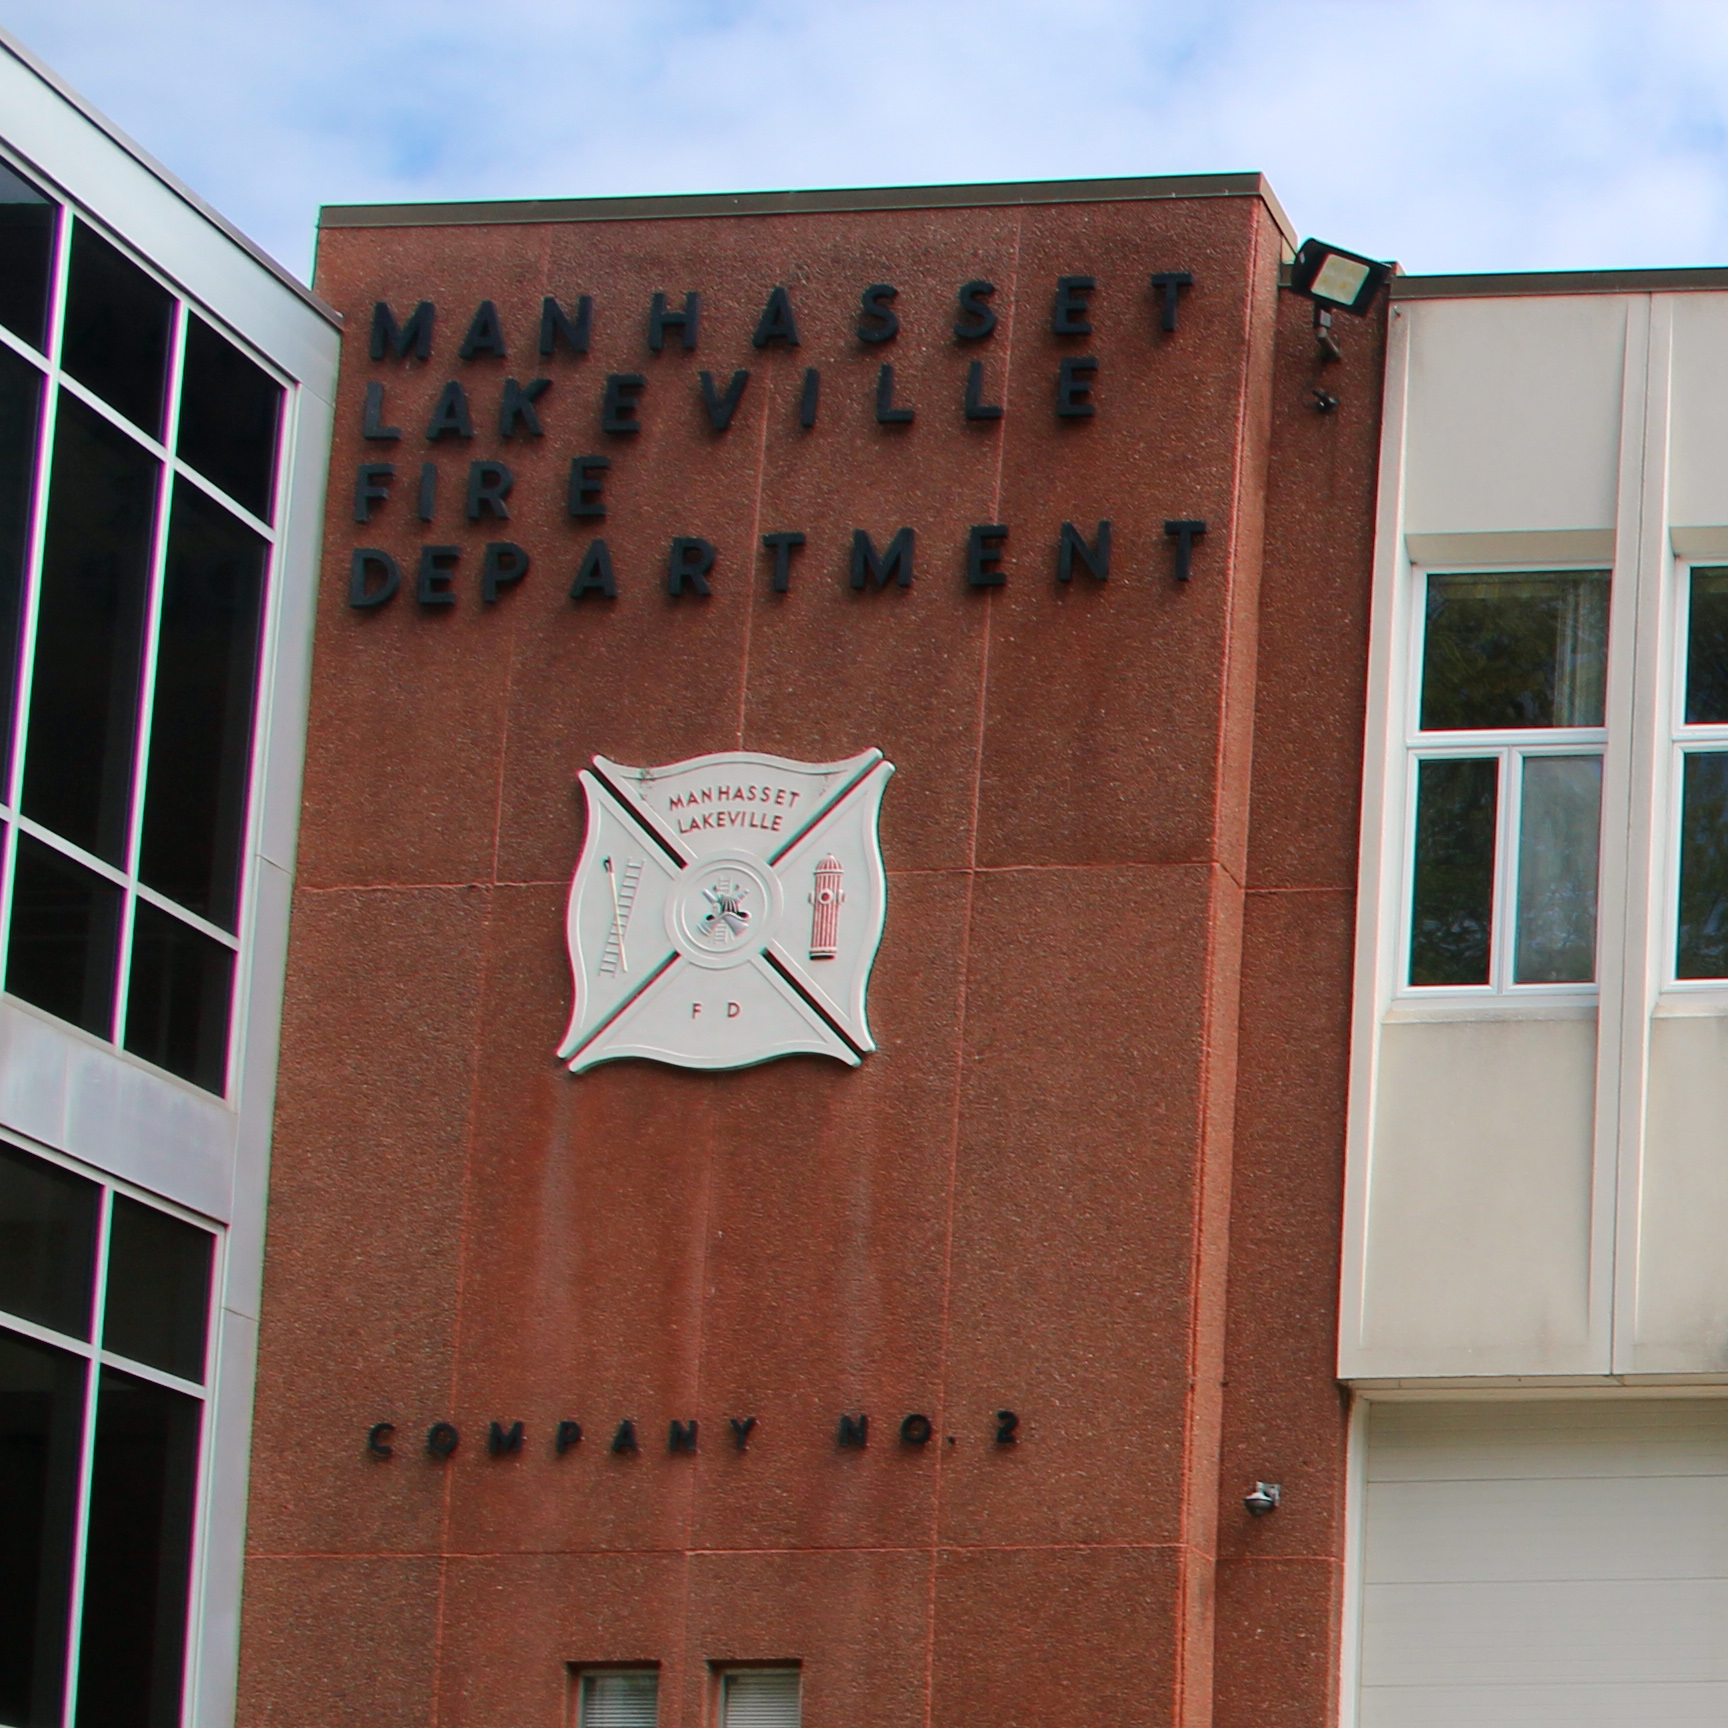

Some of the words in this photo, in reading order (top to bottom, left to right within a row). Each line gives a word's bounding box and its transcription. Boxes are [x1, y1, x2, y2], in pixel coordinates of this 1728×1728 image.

[368, 272, 1194, 361] MANHASSET
[361, 355, 1100, 442] LAKEVILLE
[352, 454, 612, 524] FIRE
[347, 518, 1207, 609] DEPARTMENT
[668, 784, 801, 811] MANHASSET
[677, 811, 784, 835] LAKEVILLE
[367, 1417, 756, 1457] COMPANY
[838, 1413, 956, 1450] NO.
[994, 1410, 1018, 1444] 2
